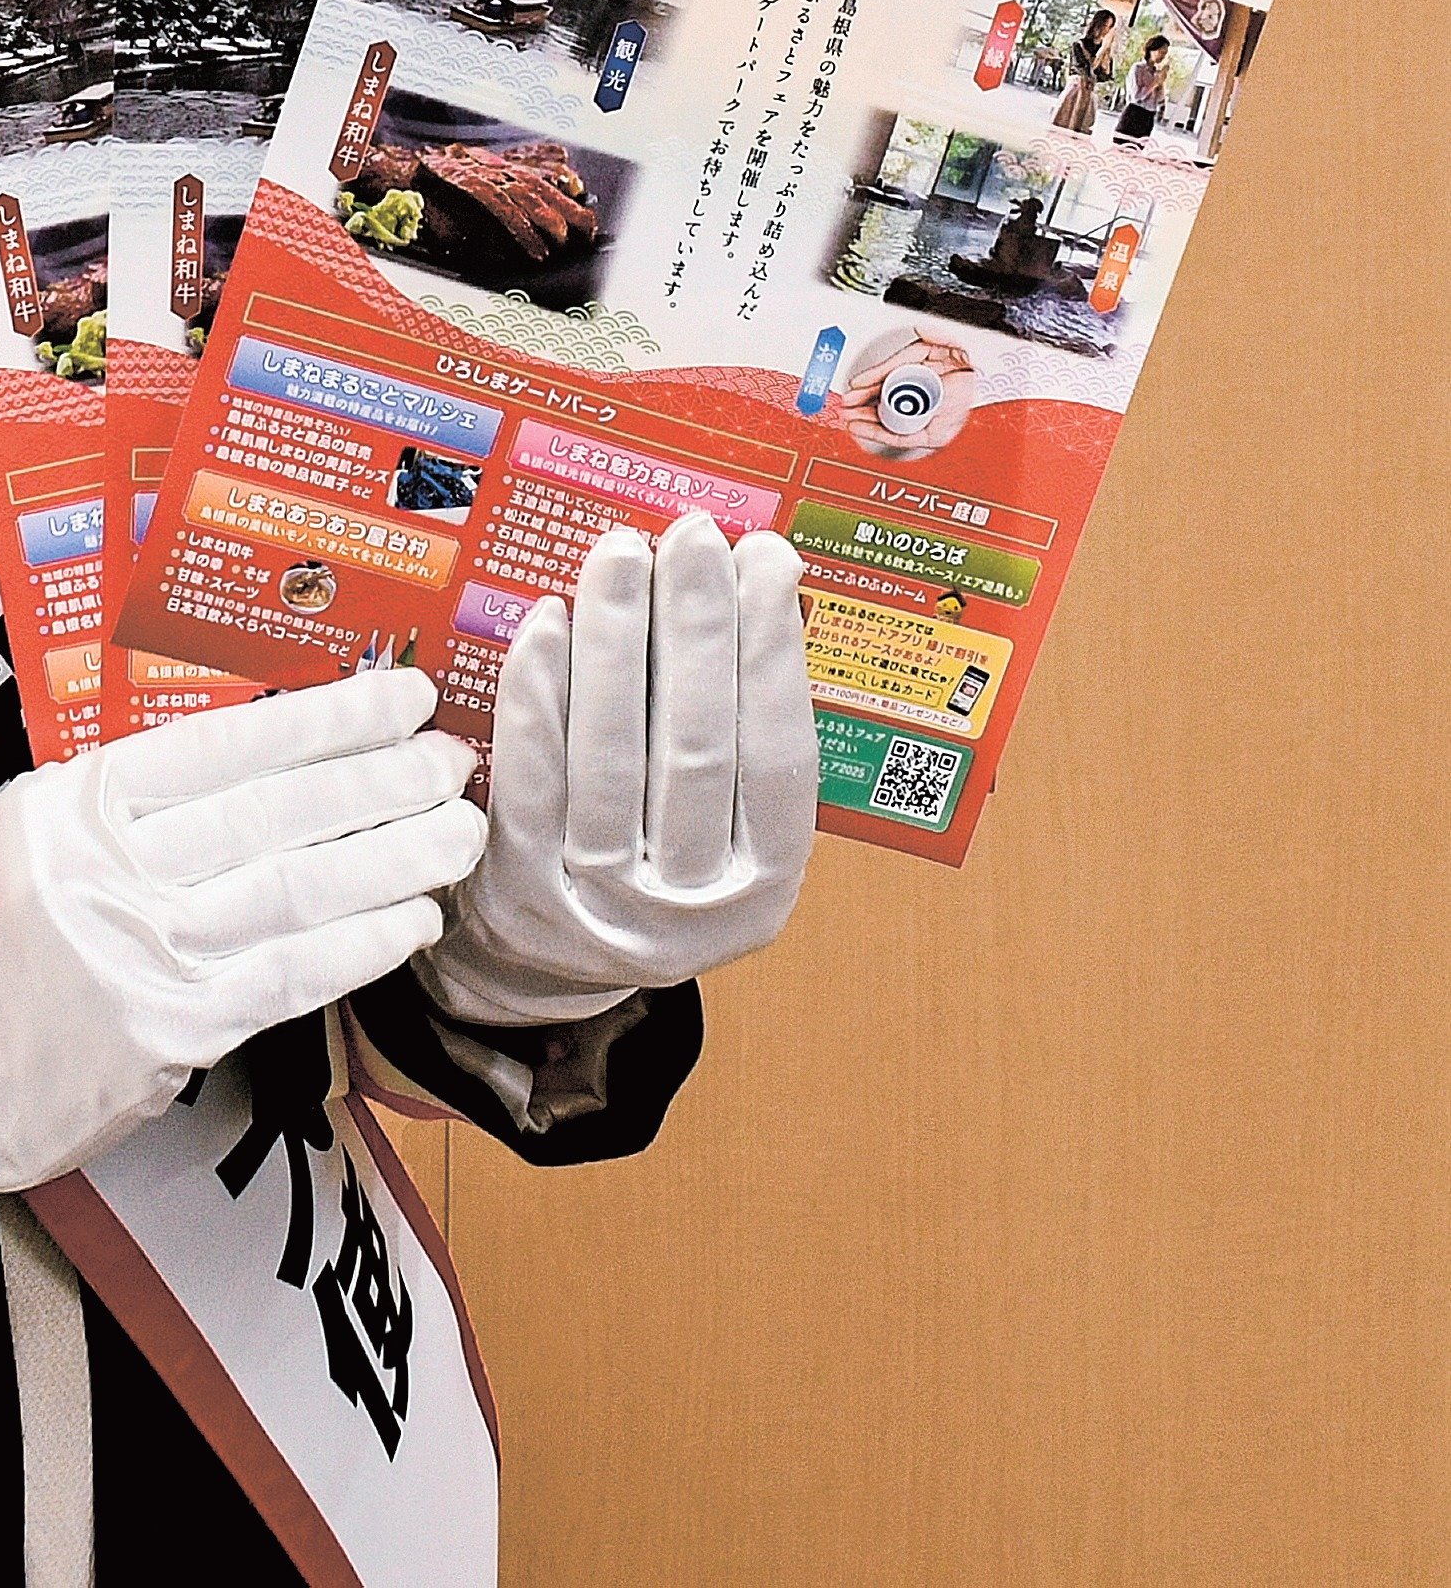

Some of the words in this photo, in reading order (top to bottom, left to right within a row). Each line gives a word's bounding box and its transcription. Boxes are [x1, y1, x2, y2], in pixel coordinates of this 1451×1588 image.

[605, 37, 637, 92] 観光
[337, 49, 388, 168] しまね和牛
[174, 185, 198, 305] しまね和牛
[1098, 242, 1130, 292] 温泉
[261, 350, 479, 430] しまねまるごとマルシェ
[435, 354, 617, 423] ひろしまゲートパーク
[549, 435, 749, 509] しまね魅力発見ゾーン
[227, 486, 430, 560] しまねあつあつ屋台村
[503, 507, 546, 531] 松江城
[869, 480, 990, 527] ハノーバー庭園
[181, 549, 224, 571] 海の幸
[242, 565, 272, 584] そば
[187, 531, 254, 560] しまね和牛
[853, 520, 969, 566] 憩いのひろば
[44, 575, 103, 599] 島根ふる
[176, 566, 260, 600] 甘味・スイーツ
[166, 598, 326, 648] 日本酒飲みくらべコーナー
[484, 594, 530, 623] しま
[142, 693, 212, 708] しまね和牛
[870, 673, 937, 702] しまねカード
